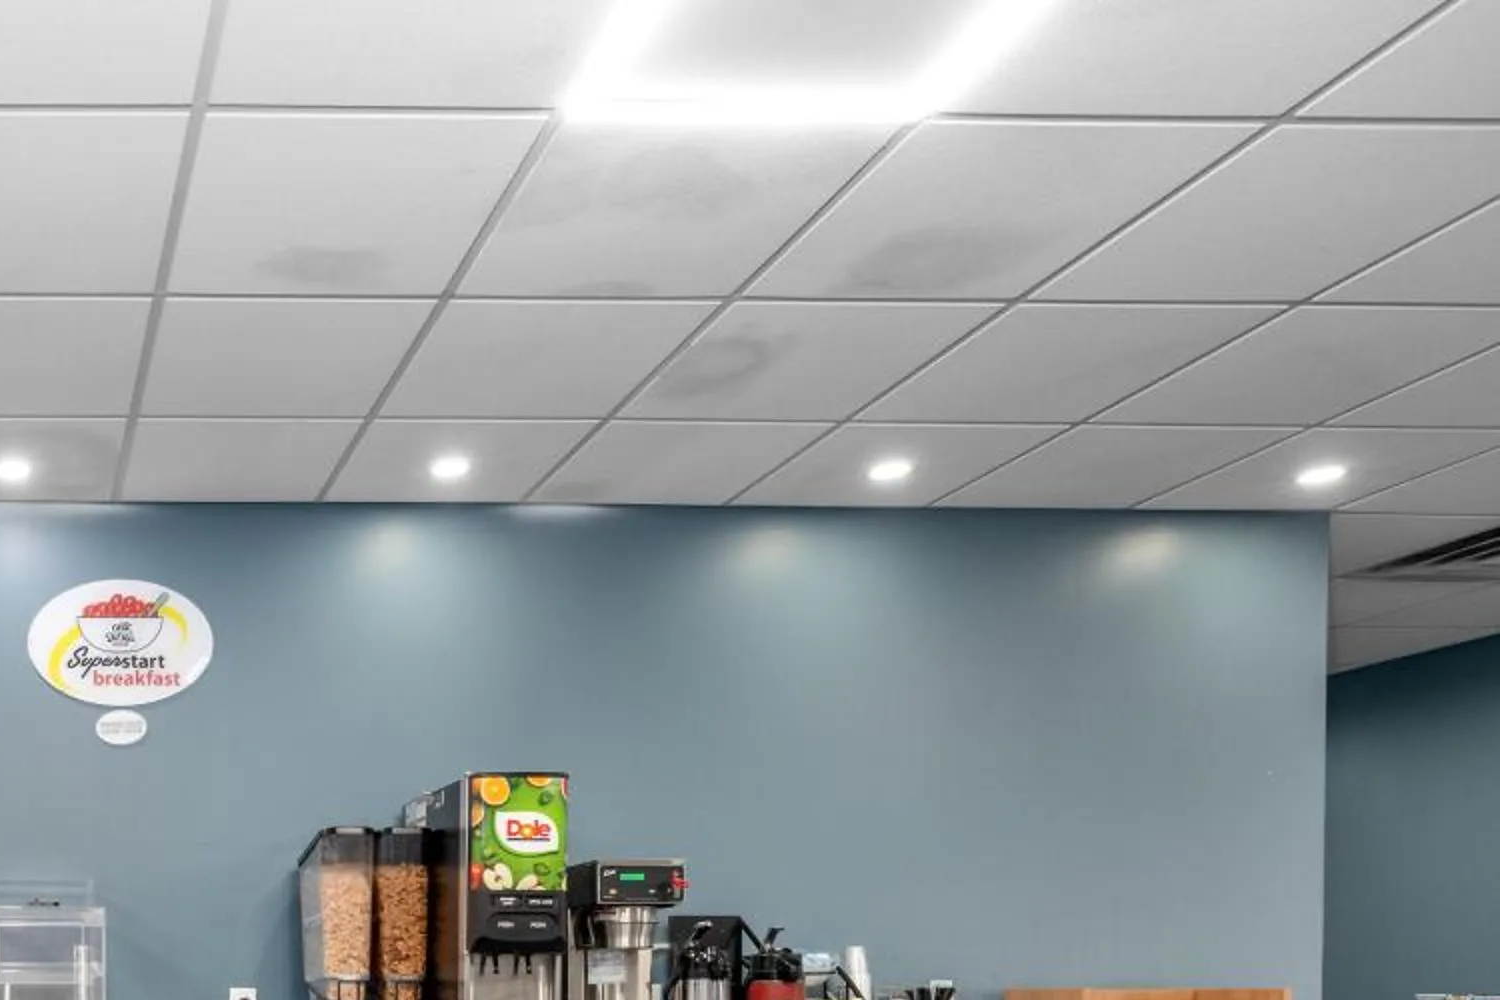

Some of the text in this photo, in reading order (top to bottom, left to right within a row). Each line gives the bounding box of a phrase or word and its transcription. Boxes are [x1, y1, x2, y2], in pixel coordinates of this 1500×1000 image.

[67, 646, 165, 679] Superstart
[93, 670, 181, 687] breakfast
[507, 819, 550, 836] Dole
